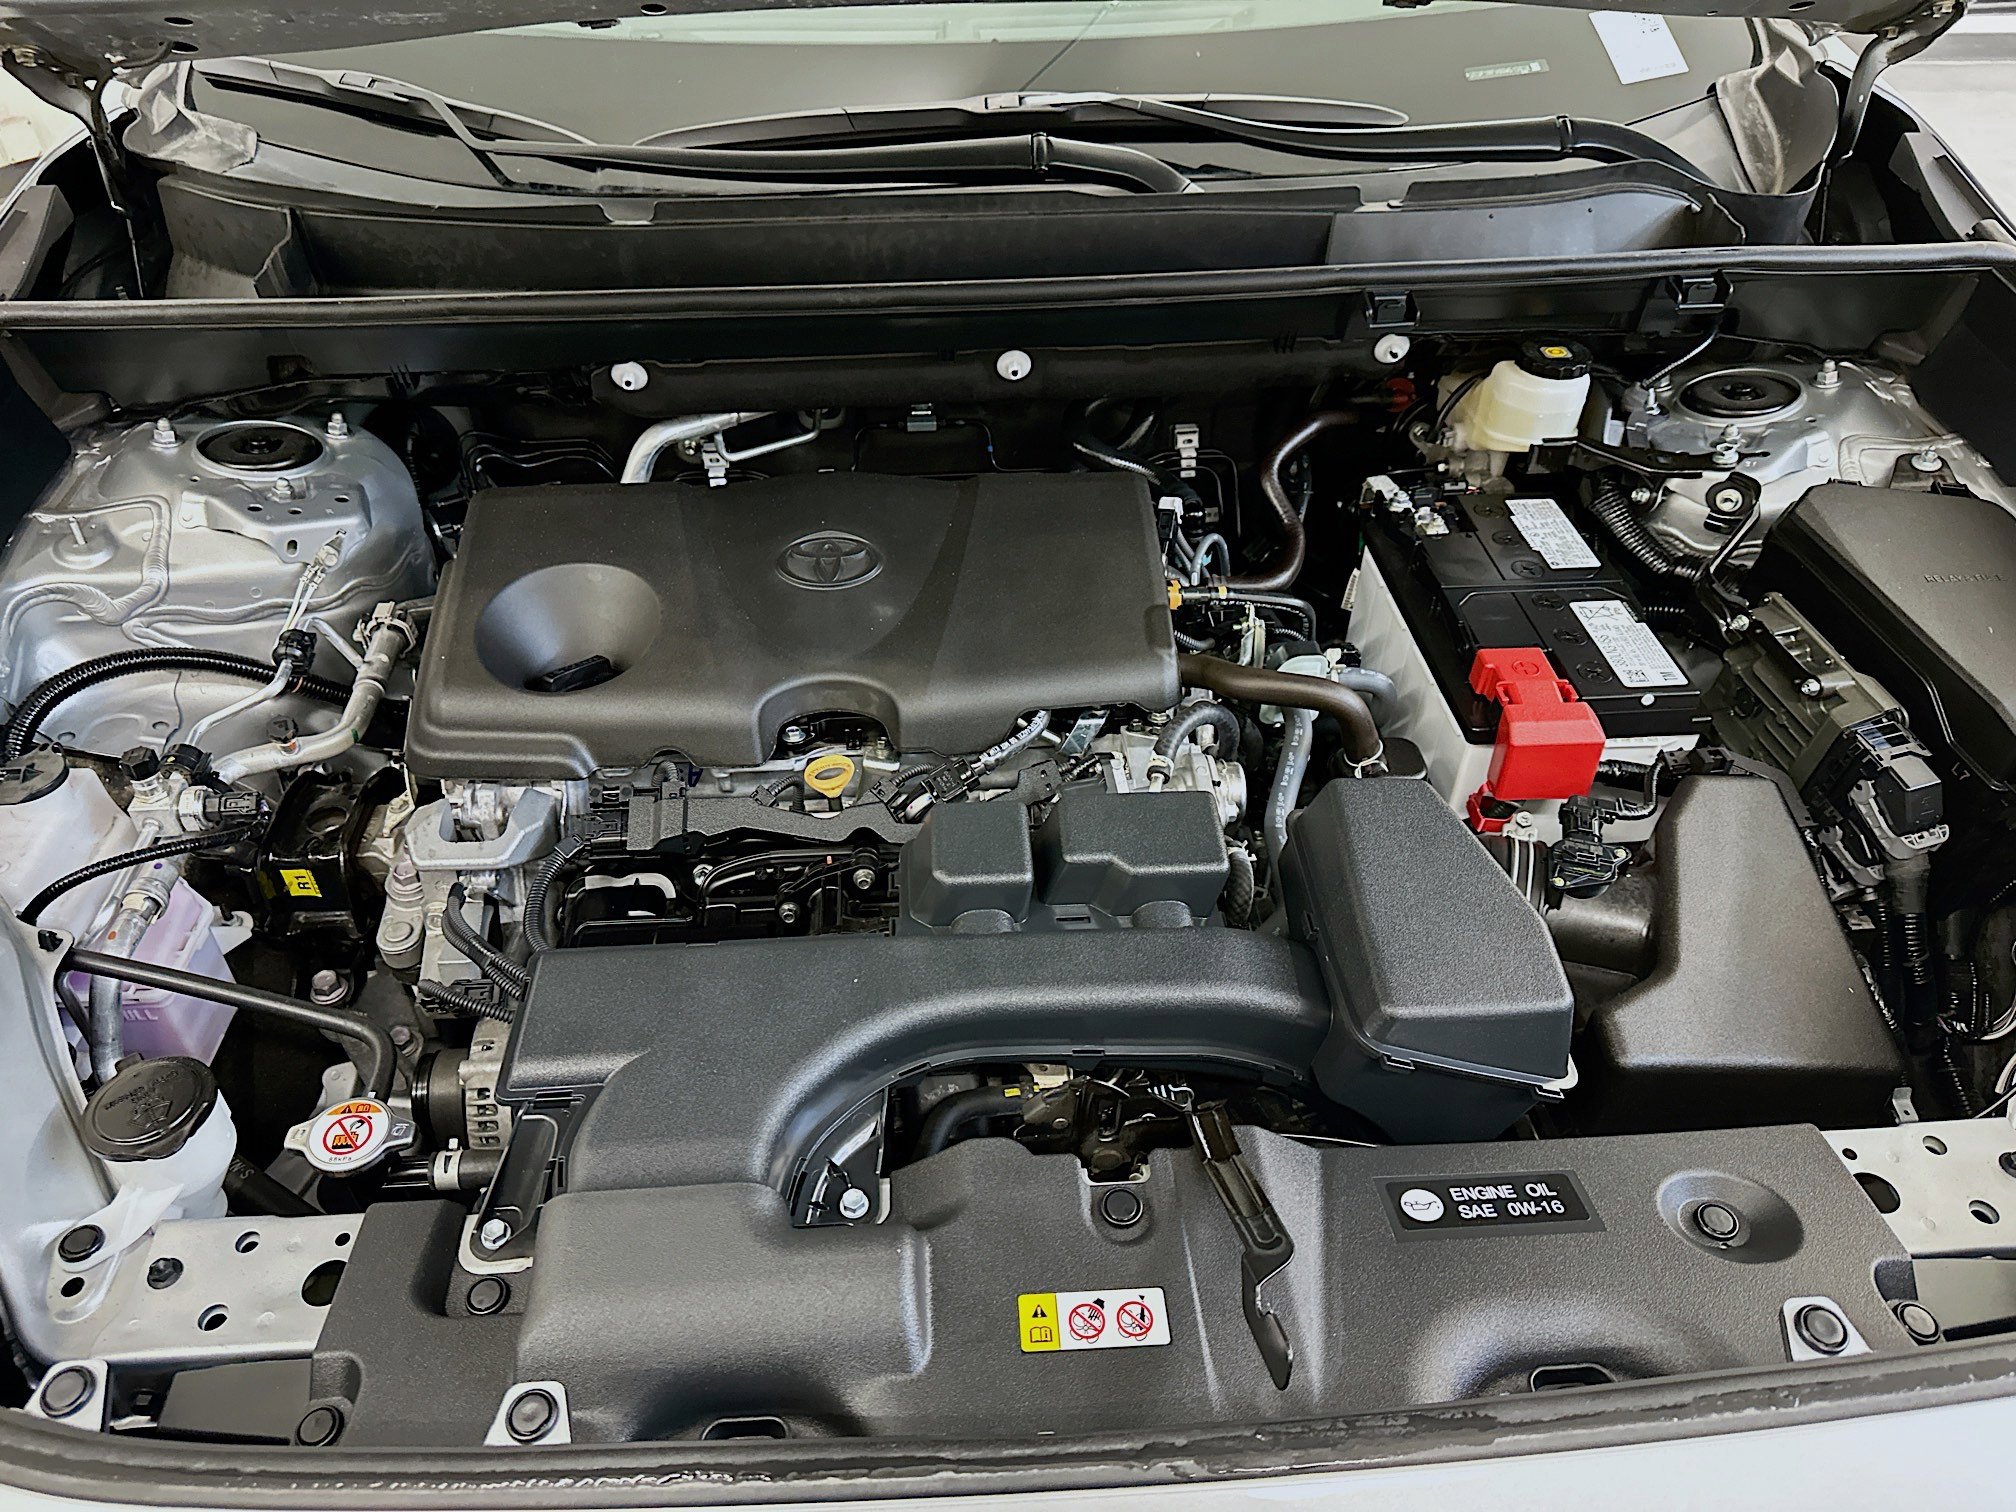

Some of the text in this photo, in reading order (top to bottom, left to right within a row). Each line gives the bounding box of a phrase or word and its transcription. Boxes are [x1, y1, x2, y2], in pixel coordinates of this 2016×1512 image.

[294, 875, 311, 889] R1
[122, 1009, 158, 1020] ULL
[1449, 1182, 1557, 1202] ENGINE OIL
[1458, 1199, 1565, 1219] SAE 0W-16
